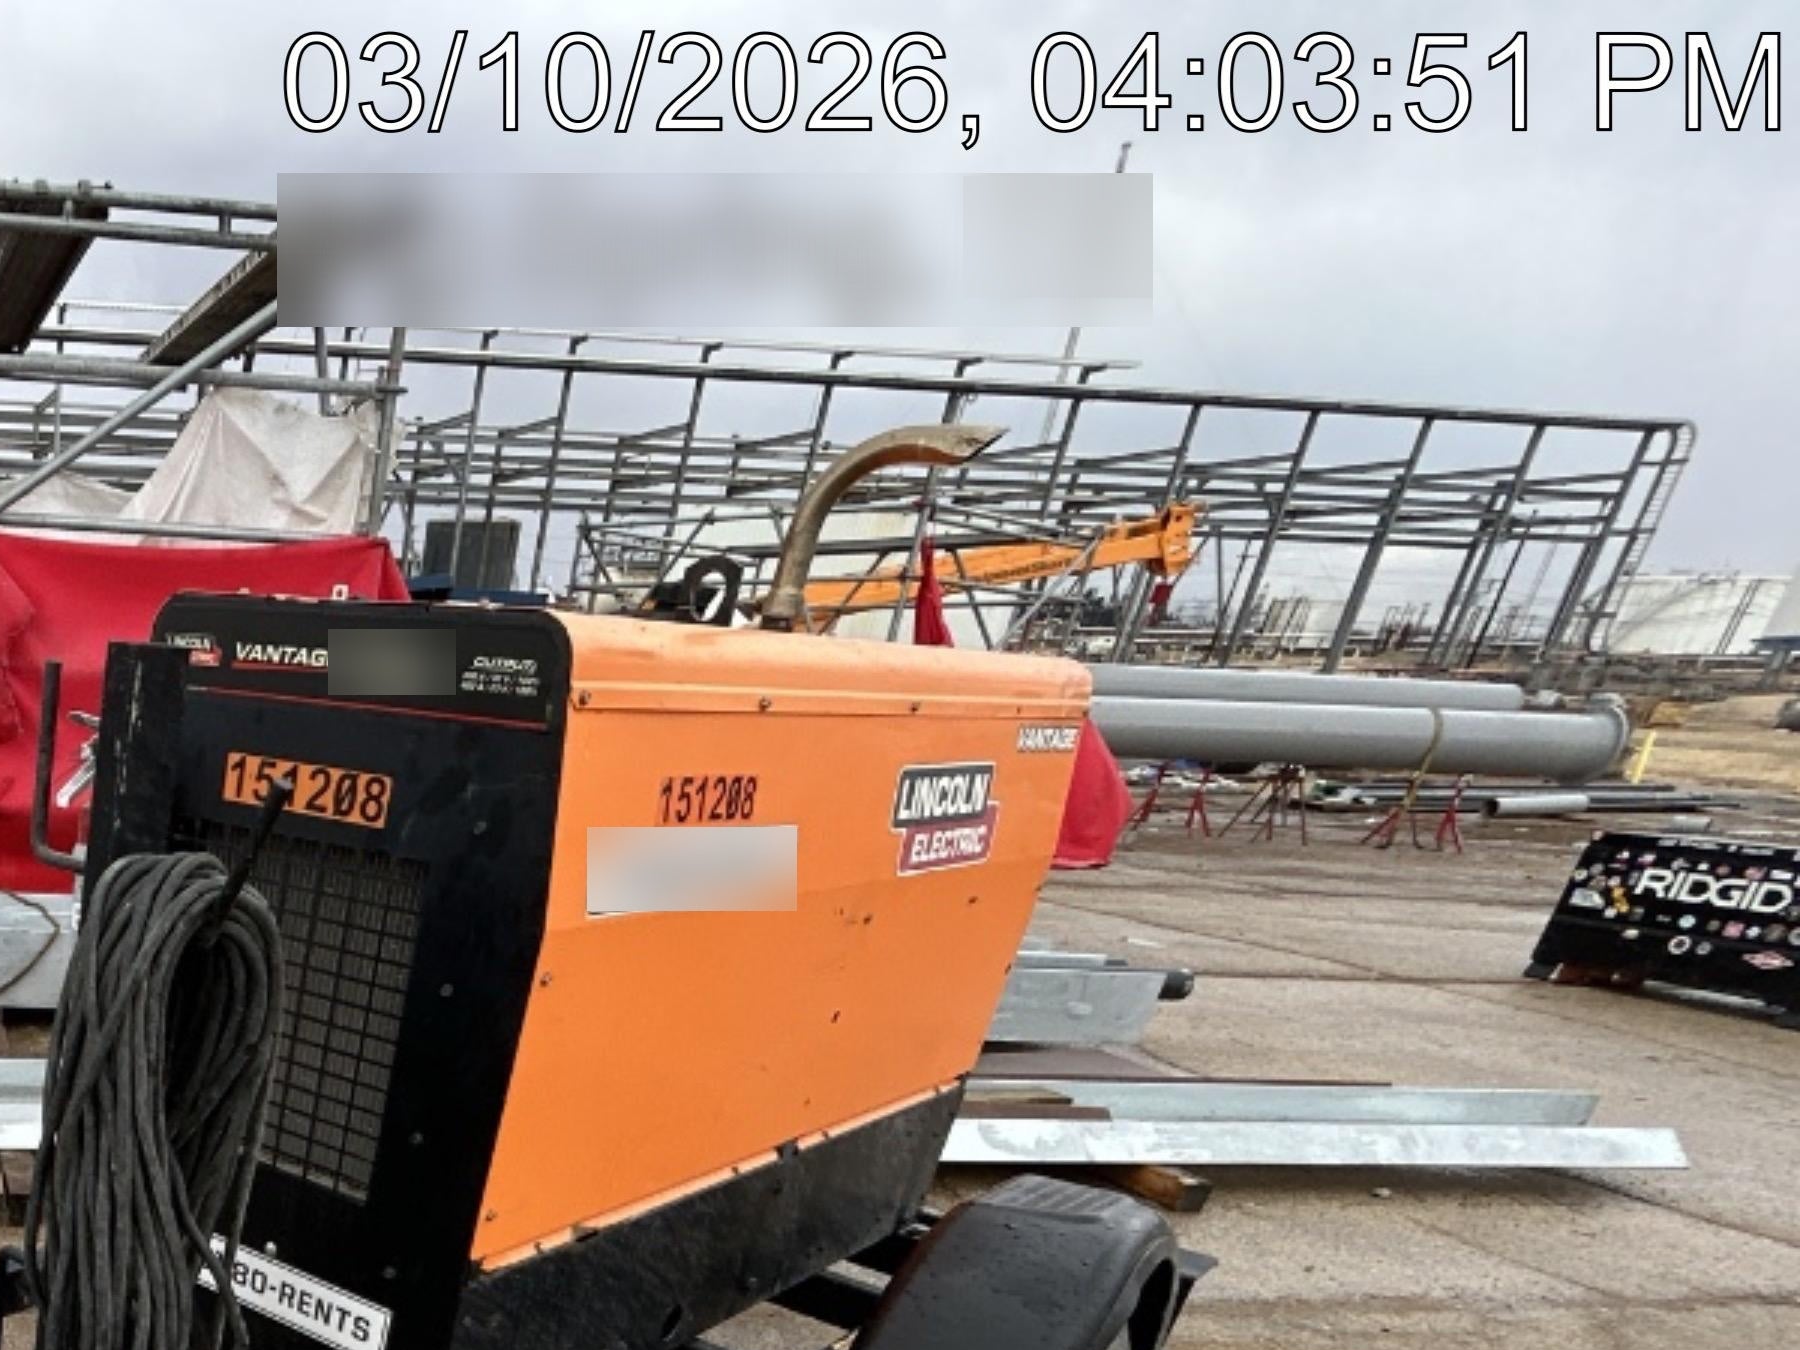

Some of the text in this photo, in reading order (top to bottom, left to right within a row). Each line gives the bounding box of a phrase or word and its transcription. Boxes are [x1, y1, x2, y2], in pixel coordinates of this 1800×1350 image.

[236, 641, 329, 667] VANTAG
[229, 755, 388, 823] 151208
[660, 775, 758, 823] 151208
[897, 773, 990, 820] LINCOLN
[909, 824, 988, 865] ELECTRIC
[1634, 868, 1794, 913] RIDGID
[214, 1250, 371, 1342] 80-RENTS
